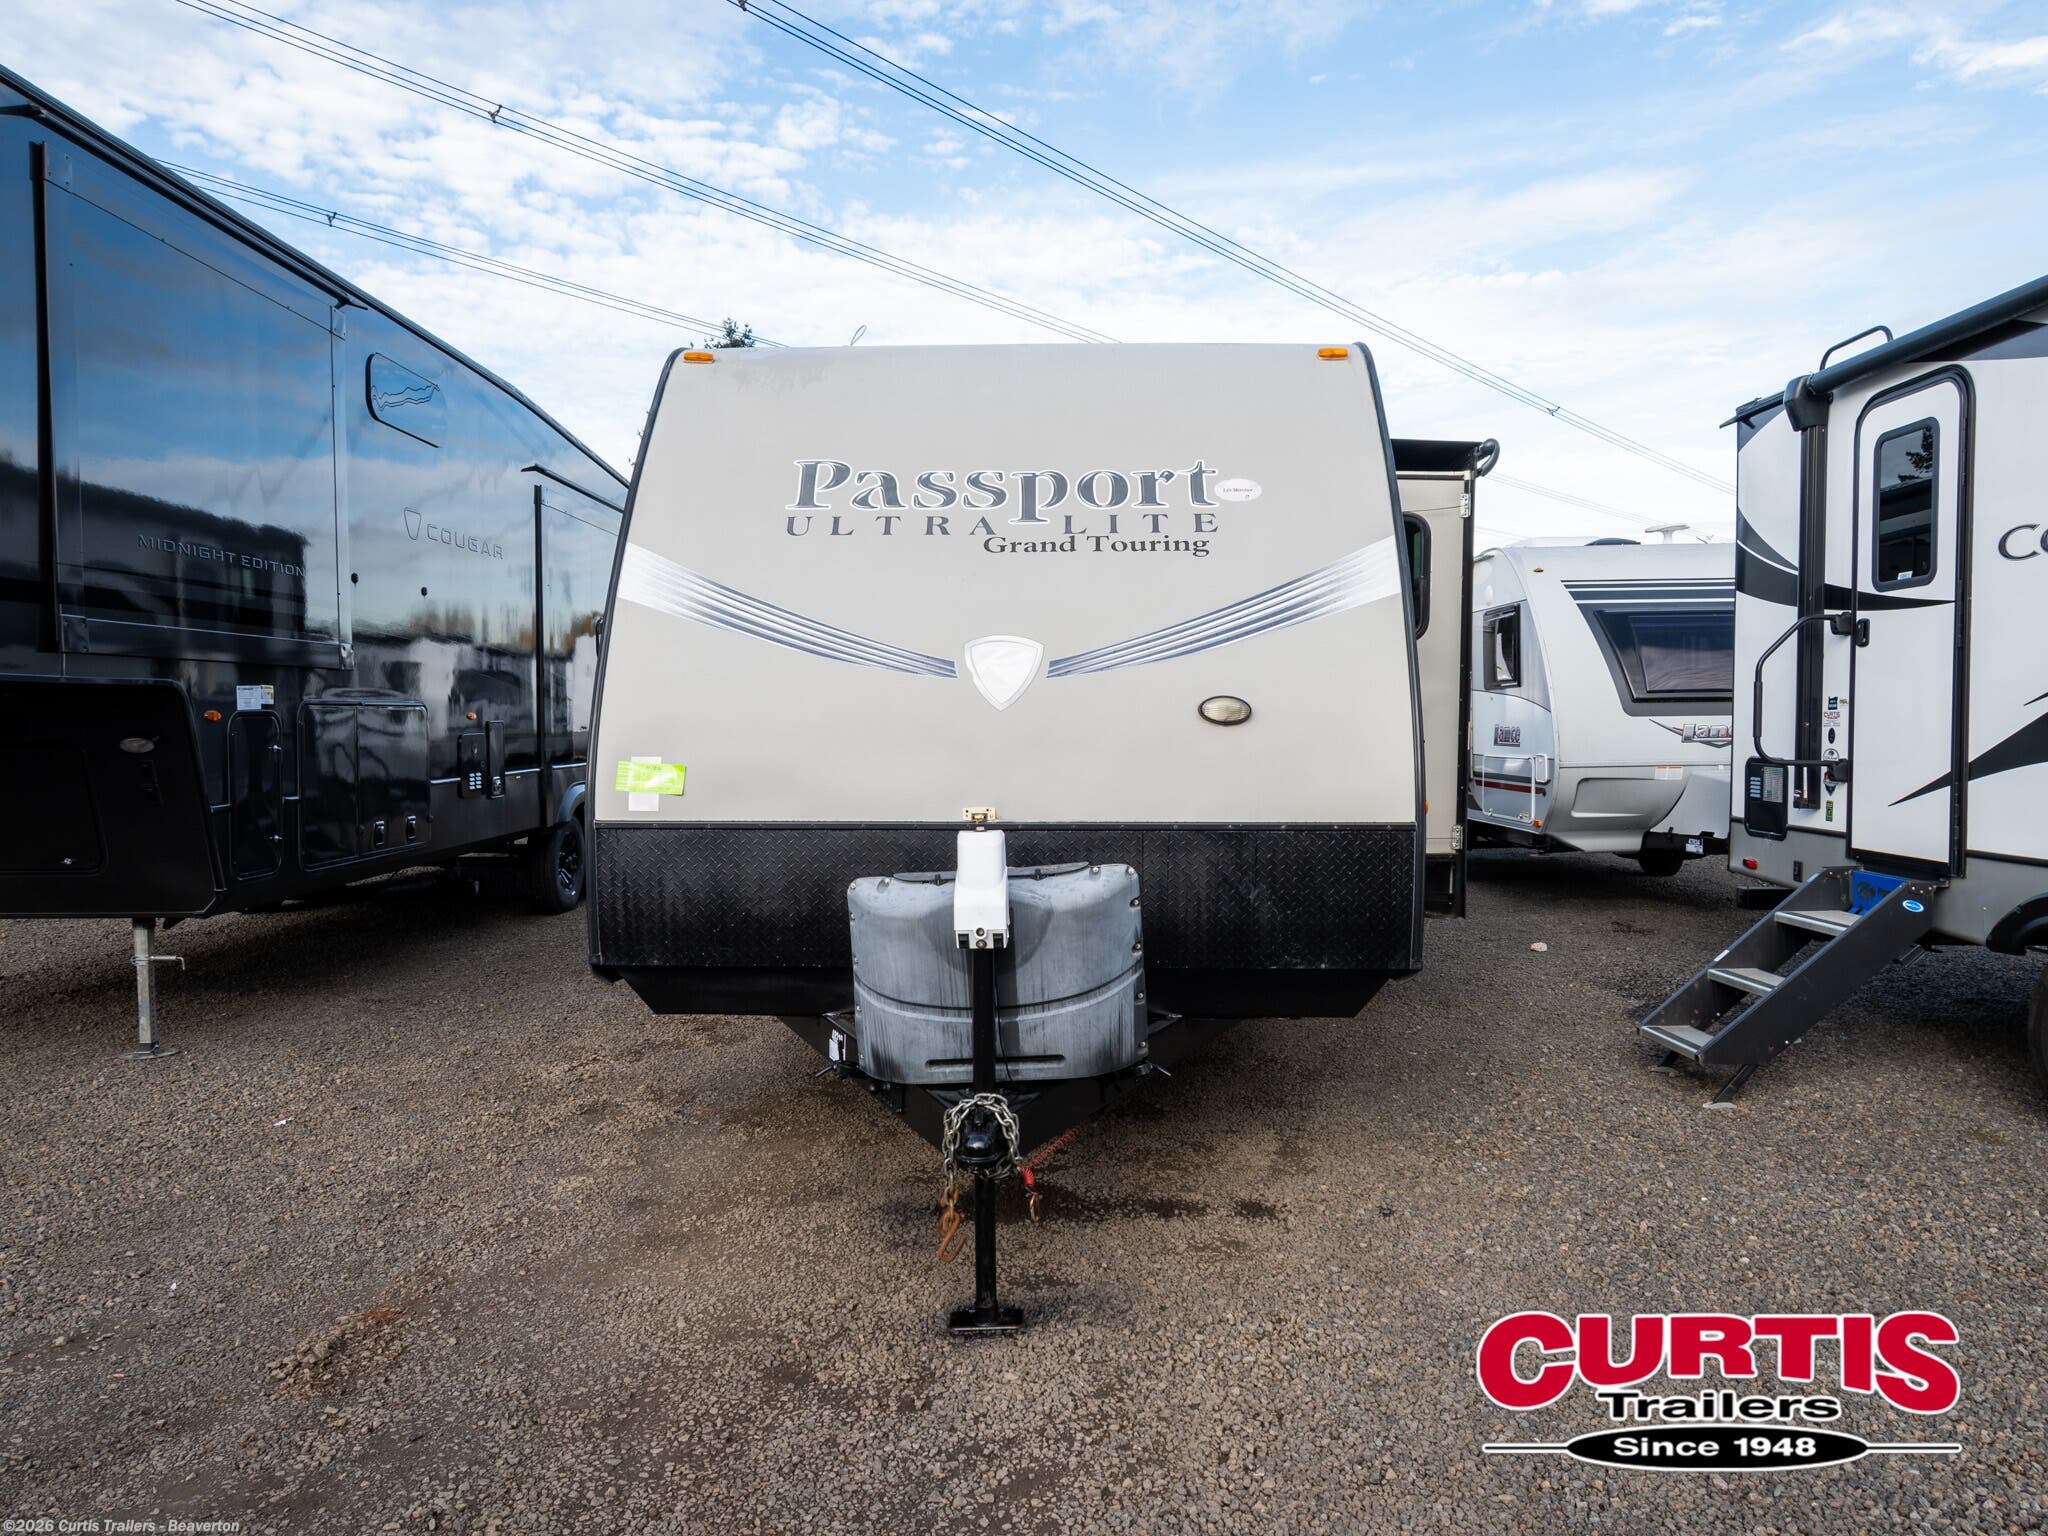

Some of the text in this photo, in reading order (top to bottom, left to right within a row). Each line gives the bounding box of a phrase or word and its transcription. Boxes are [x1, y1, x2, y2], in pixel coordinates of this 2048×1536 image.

[785, 459, 1220, 525] Passport
[426, 523, 503, 560] COUGAR
[786, 513, 1219, 537] ULTRA LITE
[1998, 523, 2048, 561] C
[137, 534, 307, 577] MIDNIGHT EDITION
[983, 535, 1210, 558] Grand Touring
